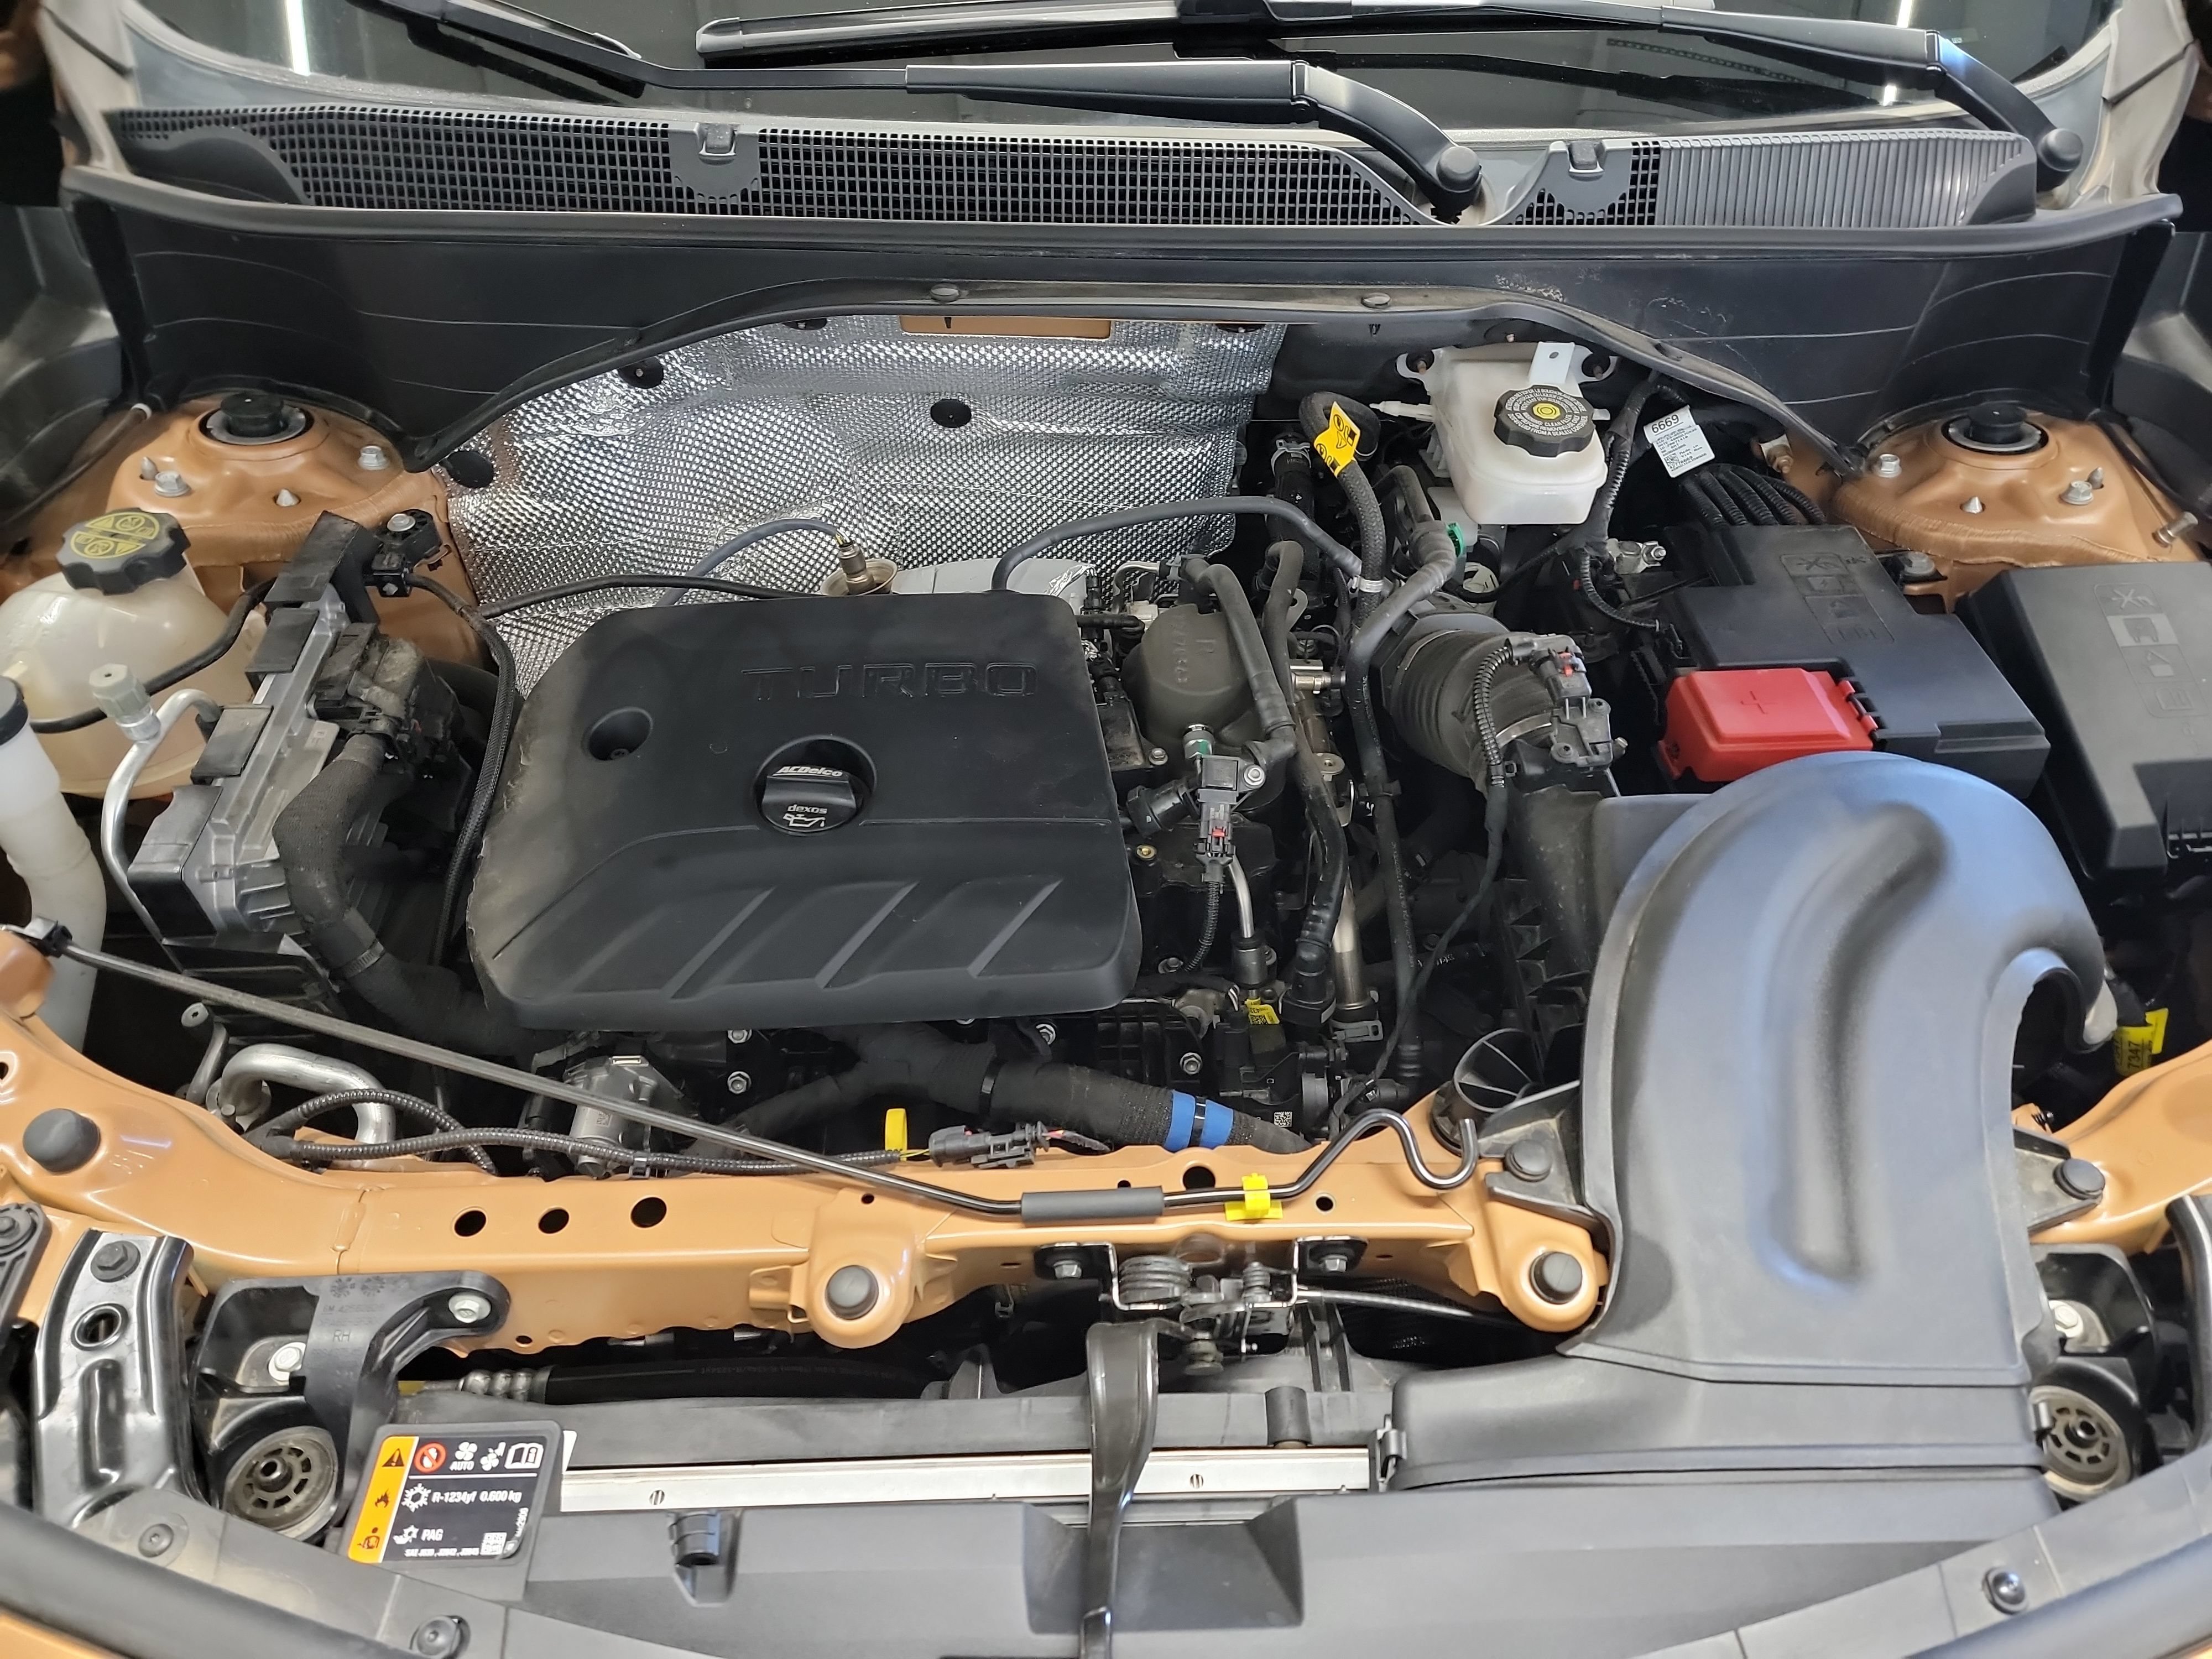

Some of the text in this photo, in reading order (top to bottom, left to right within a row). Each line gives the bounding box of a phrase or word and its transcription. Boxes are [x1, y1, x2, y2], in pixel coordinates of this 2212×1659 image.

[1652, 414, 1679, 434] 6669
[741, 662, 1037, 701] TURBO
[776, 766, 843, 777] ACDelco
[787, 804, 828, 814] dexos
[332, 1329, 351, 1342] RH
[449, 1460, 474, 1471] AUTO
[431, 1490, 523, 1504] R-1234yf 0.600 kg
[421, 1528, 444, 1541] PAG
